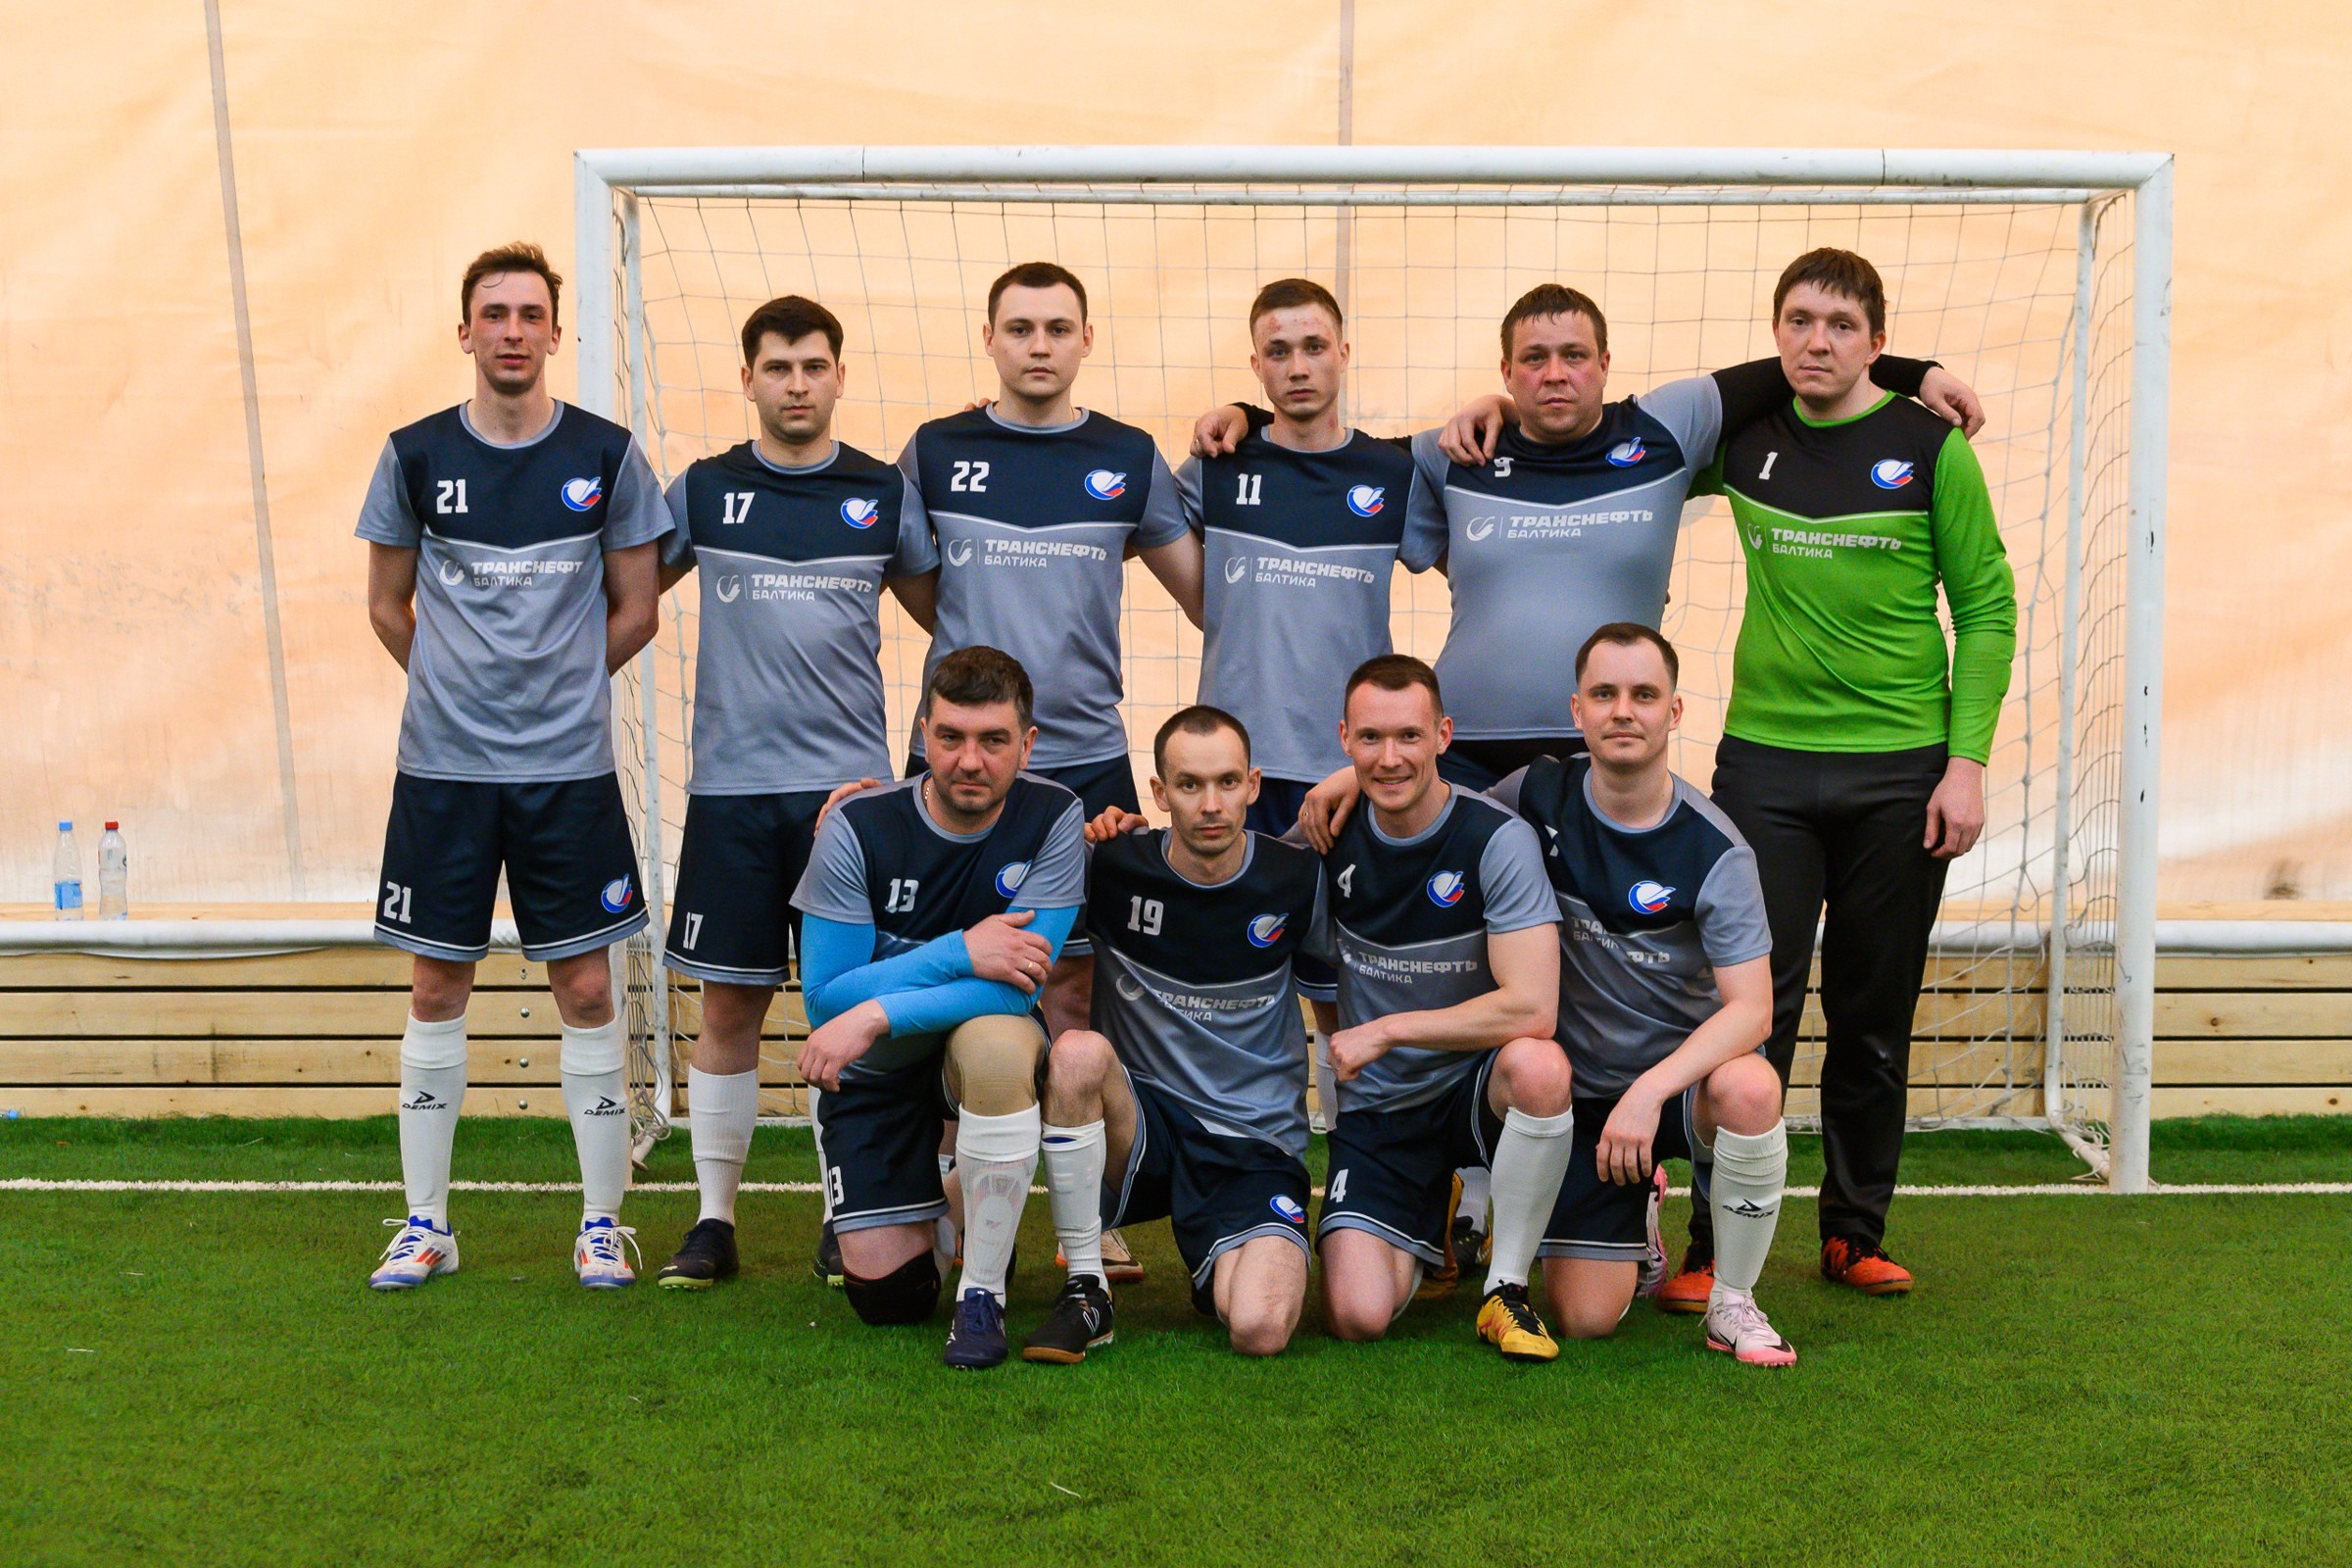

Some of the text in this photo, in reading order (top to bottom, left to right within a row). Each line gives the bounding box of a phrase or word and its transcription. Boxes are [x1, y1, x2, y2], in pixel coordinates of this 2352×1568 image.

[951, 461, 990, 493] 22
[1493, 456, 1515, 478] 9
[1758, 451, 1779, 480] 1
[436, 478, 468, 514] 21
[1236, 472, 1262, 506] 11
[722, 492, 756, 525] 17
[1509, 510, 1653, 528] ТРАНСНЕФТЬ
[1507, 527, 1582, 539] БАЛТИКА
[1771, 527, 1902, 551] ТРАНСНЕФТЬ
[984, 555, 1048, 568] БАЛТИКА
[985, 539, 1107, 562] ТРАНСНЕФТЬ
[1772, 543, 1834, 560] БАЛТИКА
[470, 560, 584, 575] ТРАНСНЕФТ
[1256, 557, 1376, 584] ТРАНСНЕФТЬ
[473, 574, 533, 587] БАЛТИКА
[751, 573, 873, 594] ТРАНСНЕФТЬ
[1255, 572, 1316, 589] БАЛТИКА
[752, 590, 815, 601] БАЛТИКА
[1337, 863, 1356, 899] 4
[383, 881, 412, 924] 21
[885, 878, 919, 913] 13
[1127, 895, 1164, 936] 19
[682, 911, 704, 951] 17
[1358, 952, 1478, 974] ТРАНСНЕФТЬ
[1358, 964, 1413, 984] БАЛТИКА
[583, 1107, 626, 1116] DEMIX
[1329, 1168, 1348, 1203] 4
